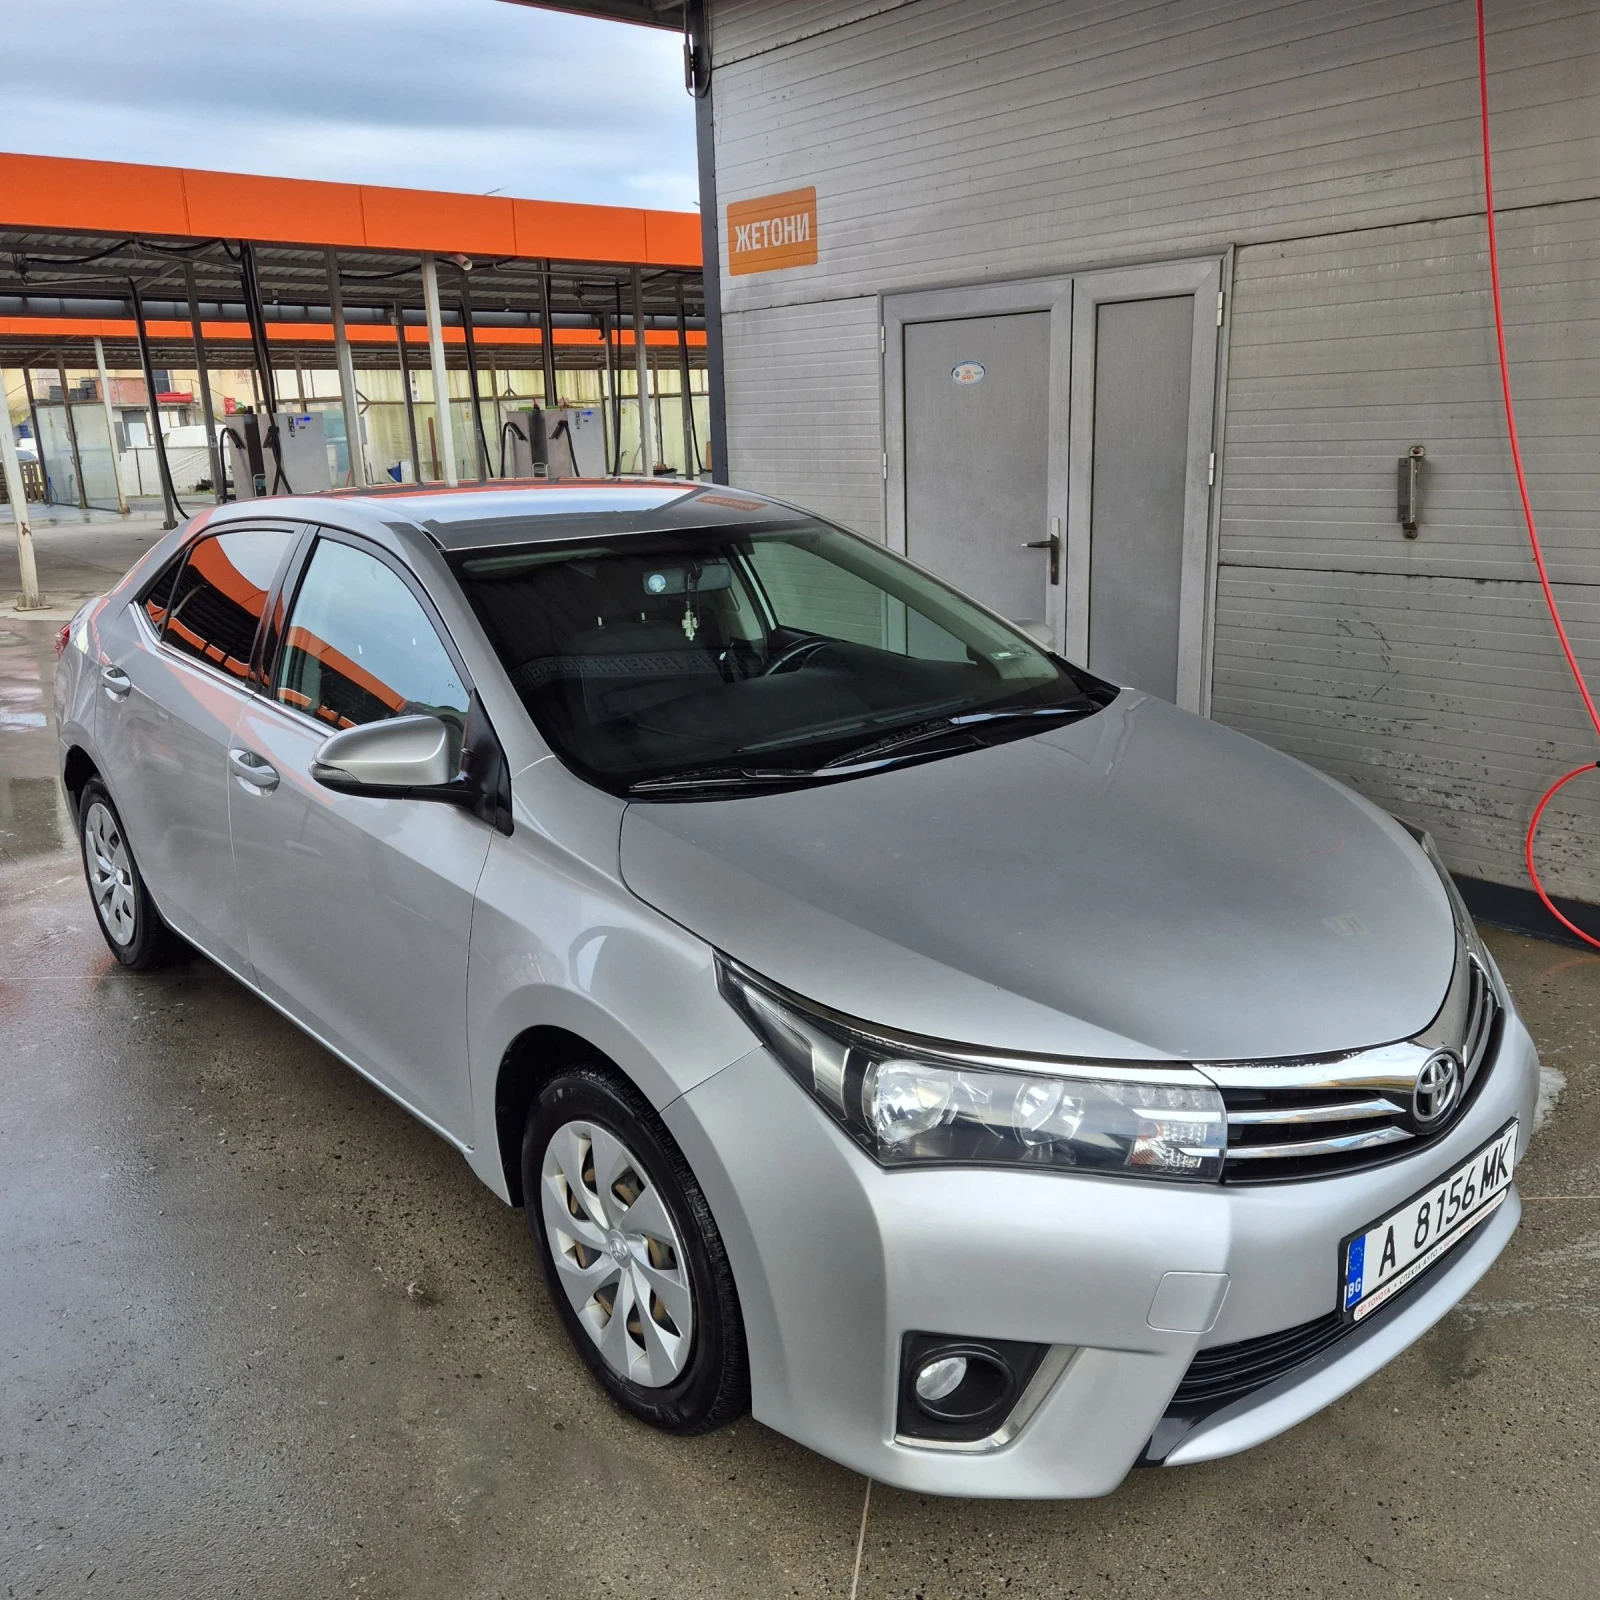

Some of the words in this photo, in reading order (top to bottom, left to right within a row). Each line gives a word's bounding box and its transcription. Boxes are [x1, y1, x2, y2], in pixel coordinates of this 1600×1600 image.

[735, 212, 809, 253] ЖЕТОНИ
[1378, 1225, 1396, 1278] A
[1413, 1165, 1475, 1249] 8156
[1479, 1135, 1512, 1199] MK
[1348, 1277, 1361, 1299] BG
[1367, 1287, 1391, 1308] TOYOTA
